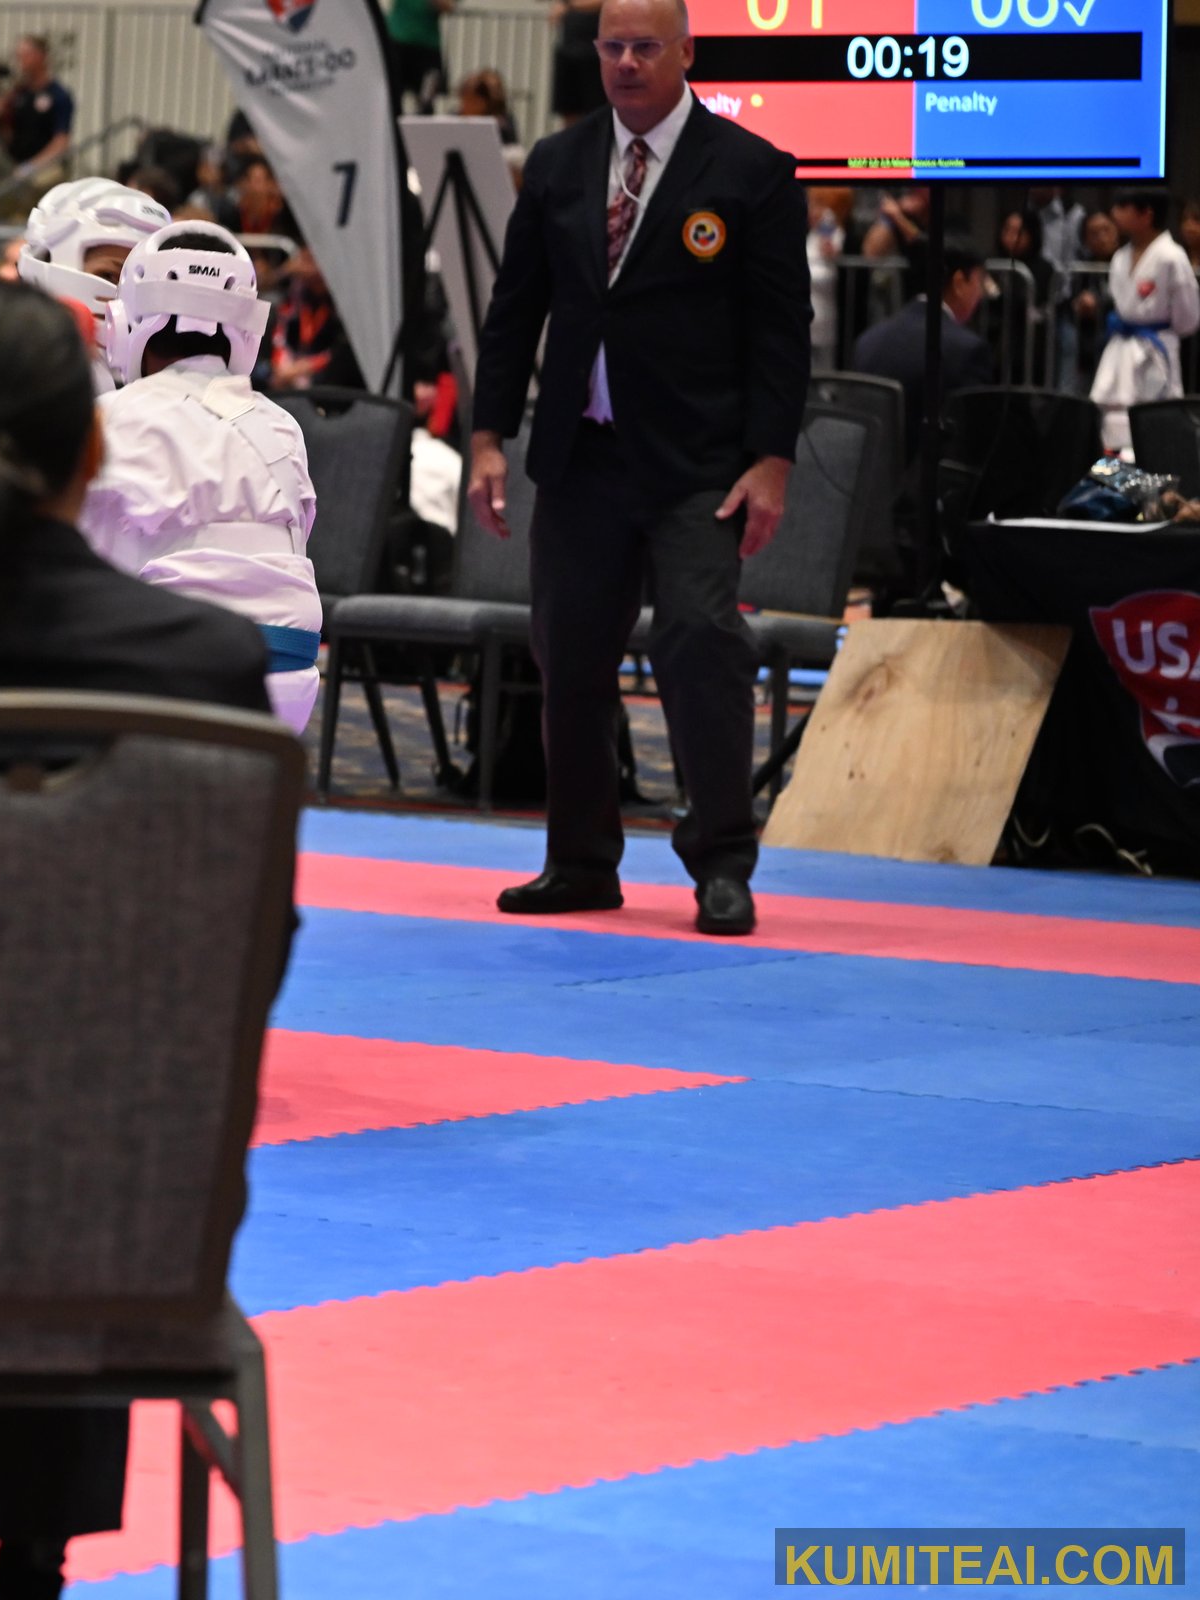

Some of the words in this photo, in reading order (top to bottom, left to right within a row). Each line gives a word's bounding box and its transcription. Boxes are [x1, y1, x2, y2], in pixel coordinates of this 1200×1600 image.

[847, 36, 970, 78] 00:19
[925, 91, 998, 116] Penalty
[188, 264, 220, 277] SMAI
